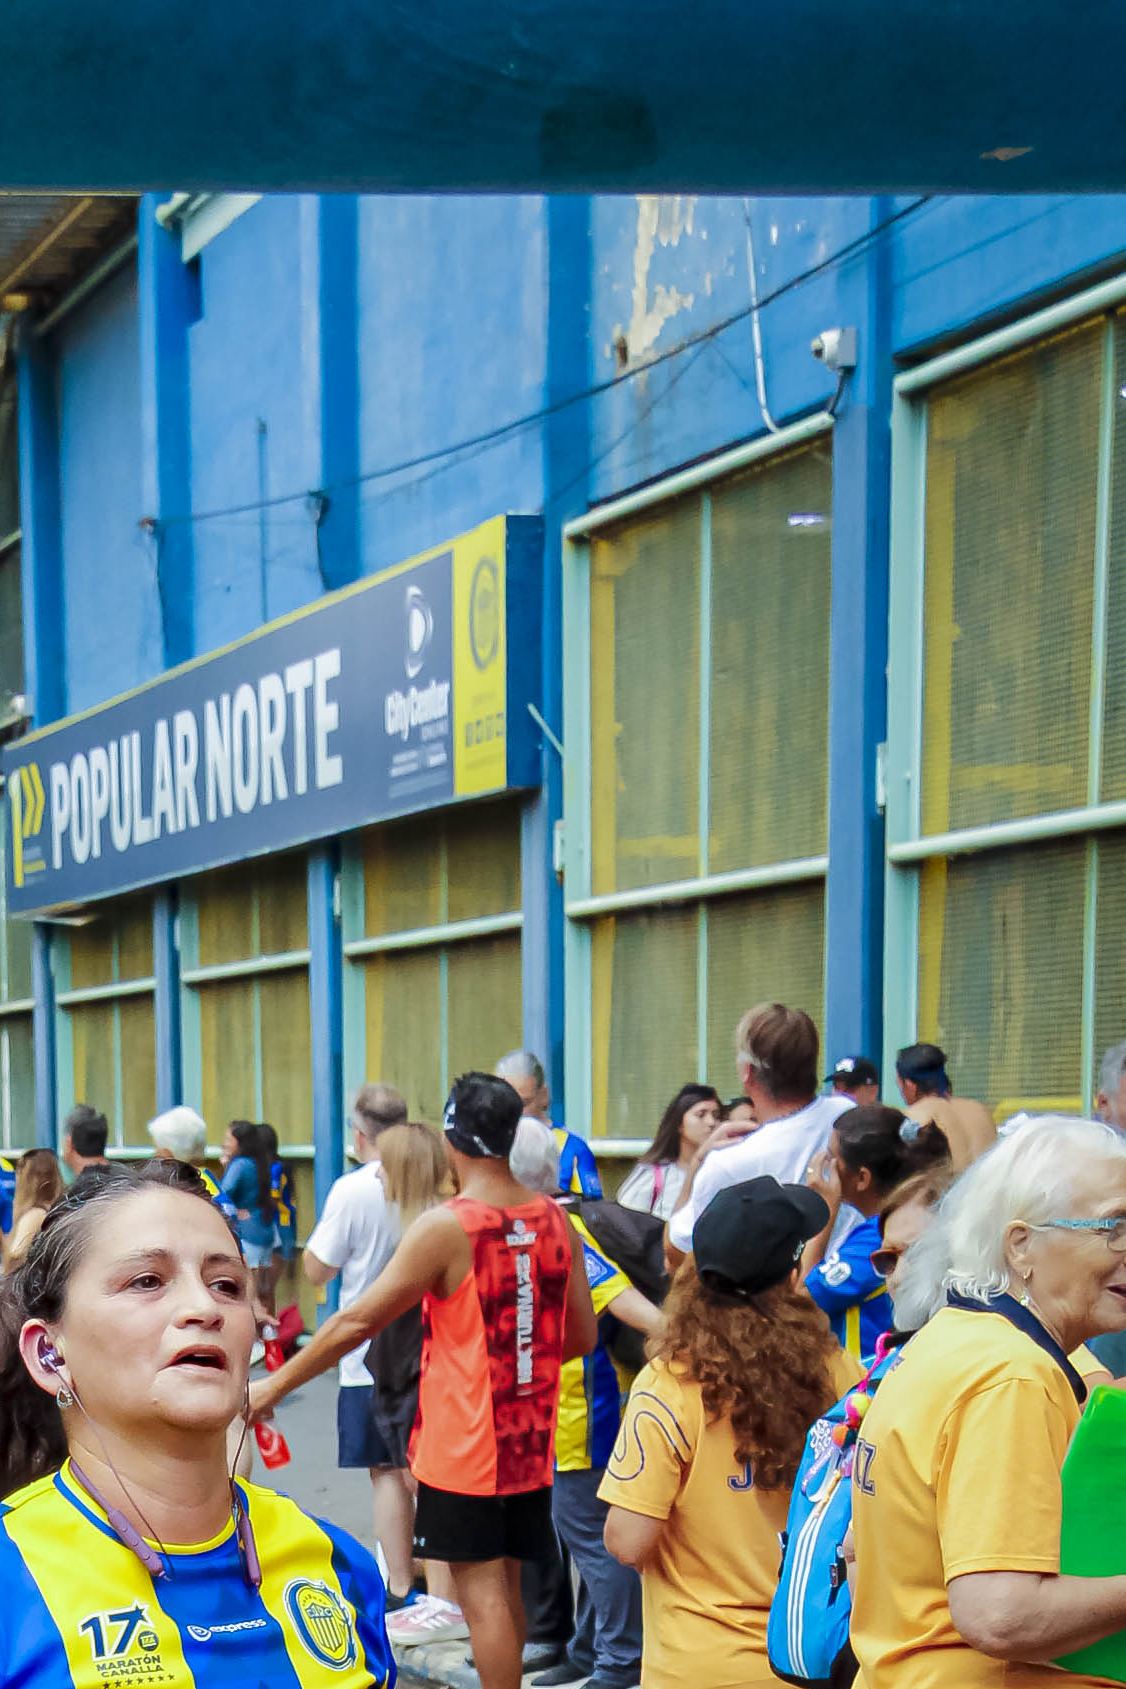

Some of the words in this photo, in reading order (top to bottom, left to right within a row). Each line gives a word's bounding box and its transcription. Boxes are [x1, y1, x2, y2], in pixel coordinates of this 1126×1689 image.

[50, 711, 200, 870] POPULAR
[205, 648, 343, 822] NORTE
[80, 1605, 148, 1659] 17
[209, 1618, 267, 1633] express
[96, 1654, 161, 1672] MARATÓN
[101, 1664, 164, 1678] CANALLA
